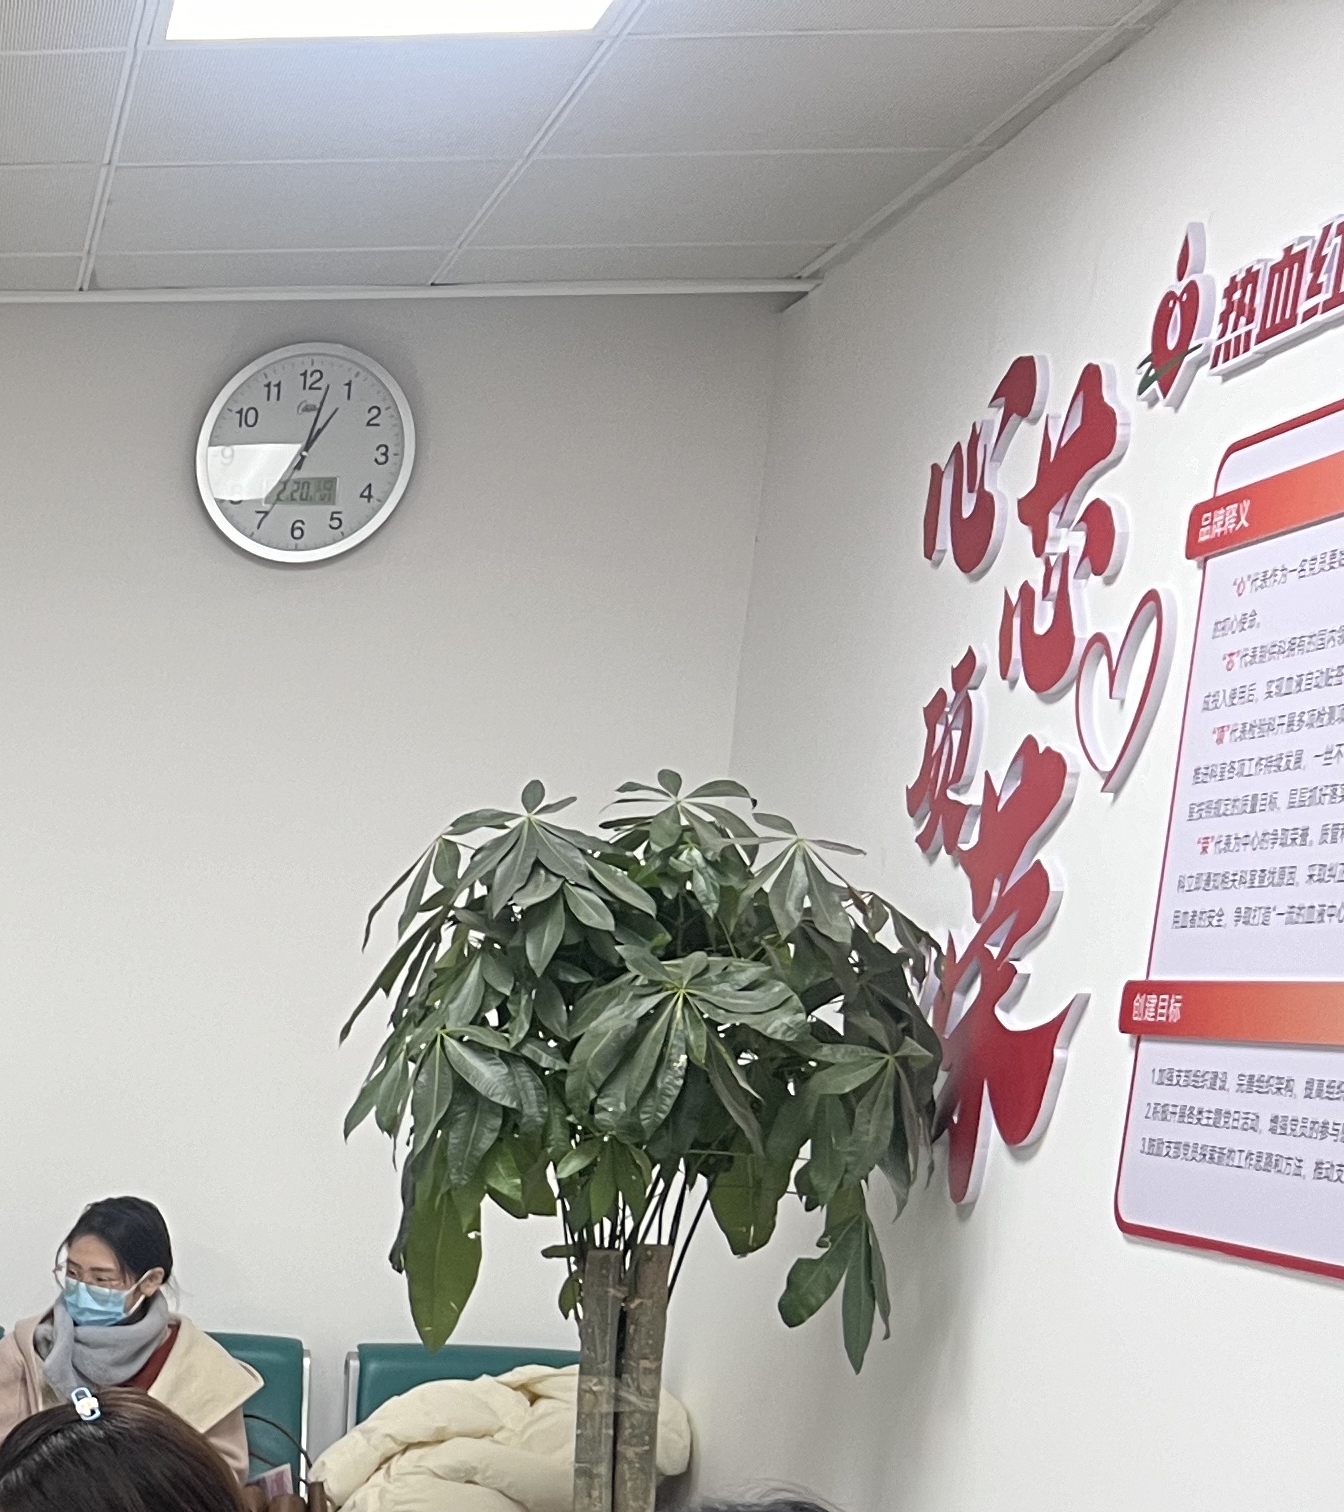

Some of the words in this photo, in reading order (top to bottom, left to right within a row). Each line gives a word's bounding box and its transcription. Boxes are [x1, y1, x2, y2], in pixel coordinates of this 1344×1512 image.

[299, 369, 324, 390] 12
[343, 380, 353, 400] 1
[263, 381, 282, 402] 11
[235, 407, 259, 428] 10
[366, 405, 381, 427] 2
[374, 444, 389, 465] 3
[359, 483, 373, 503] 4
[254, 510, 269, 530] 7
[290, 519, 305, 540] 6
[329, 511, 343, 531] 5
[1132, 993, 1183, 1023] 创建目标
